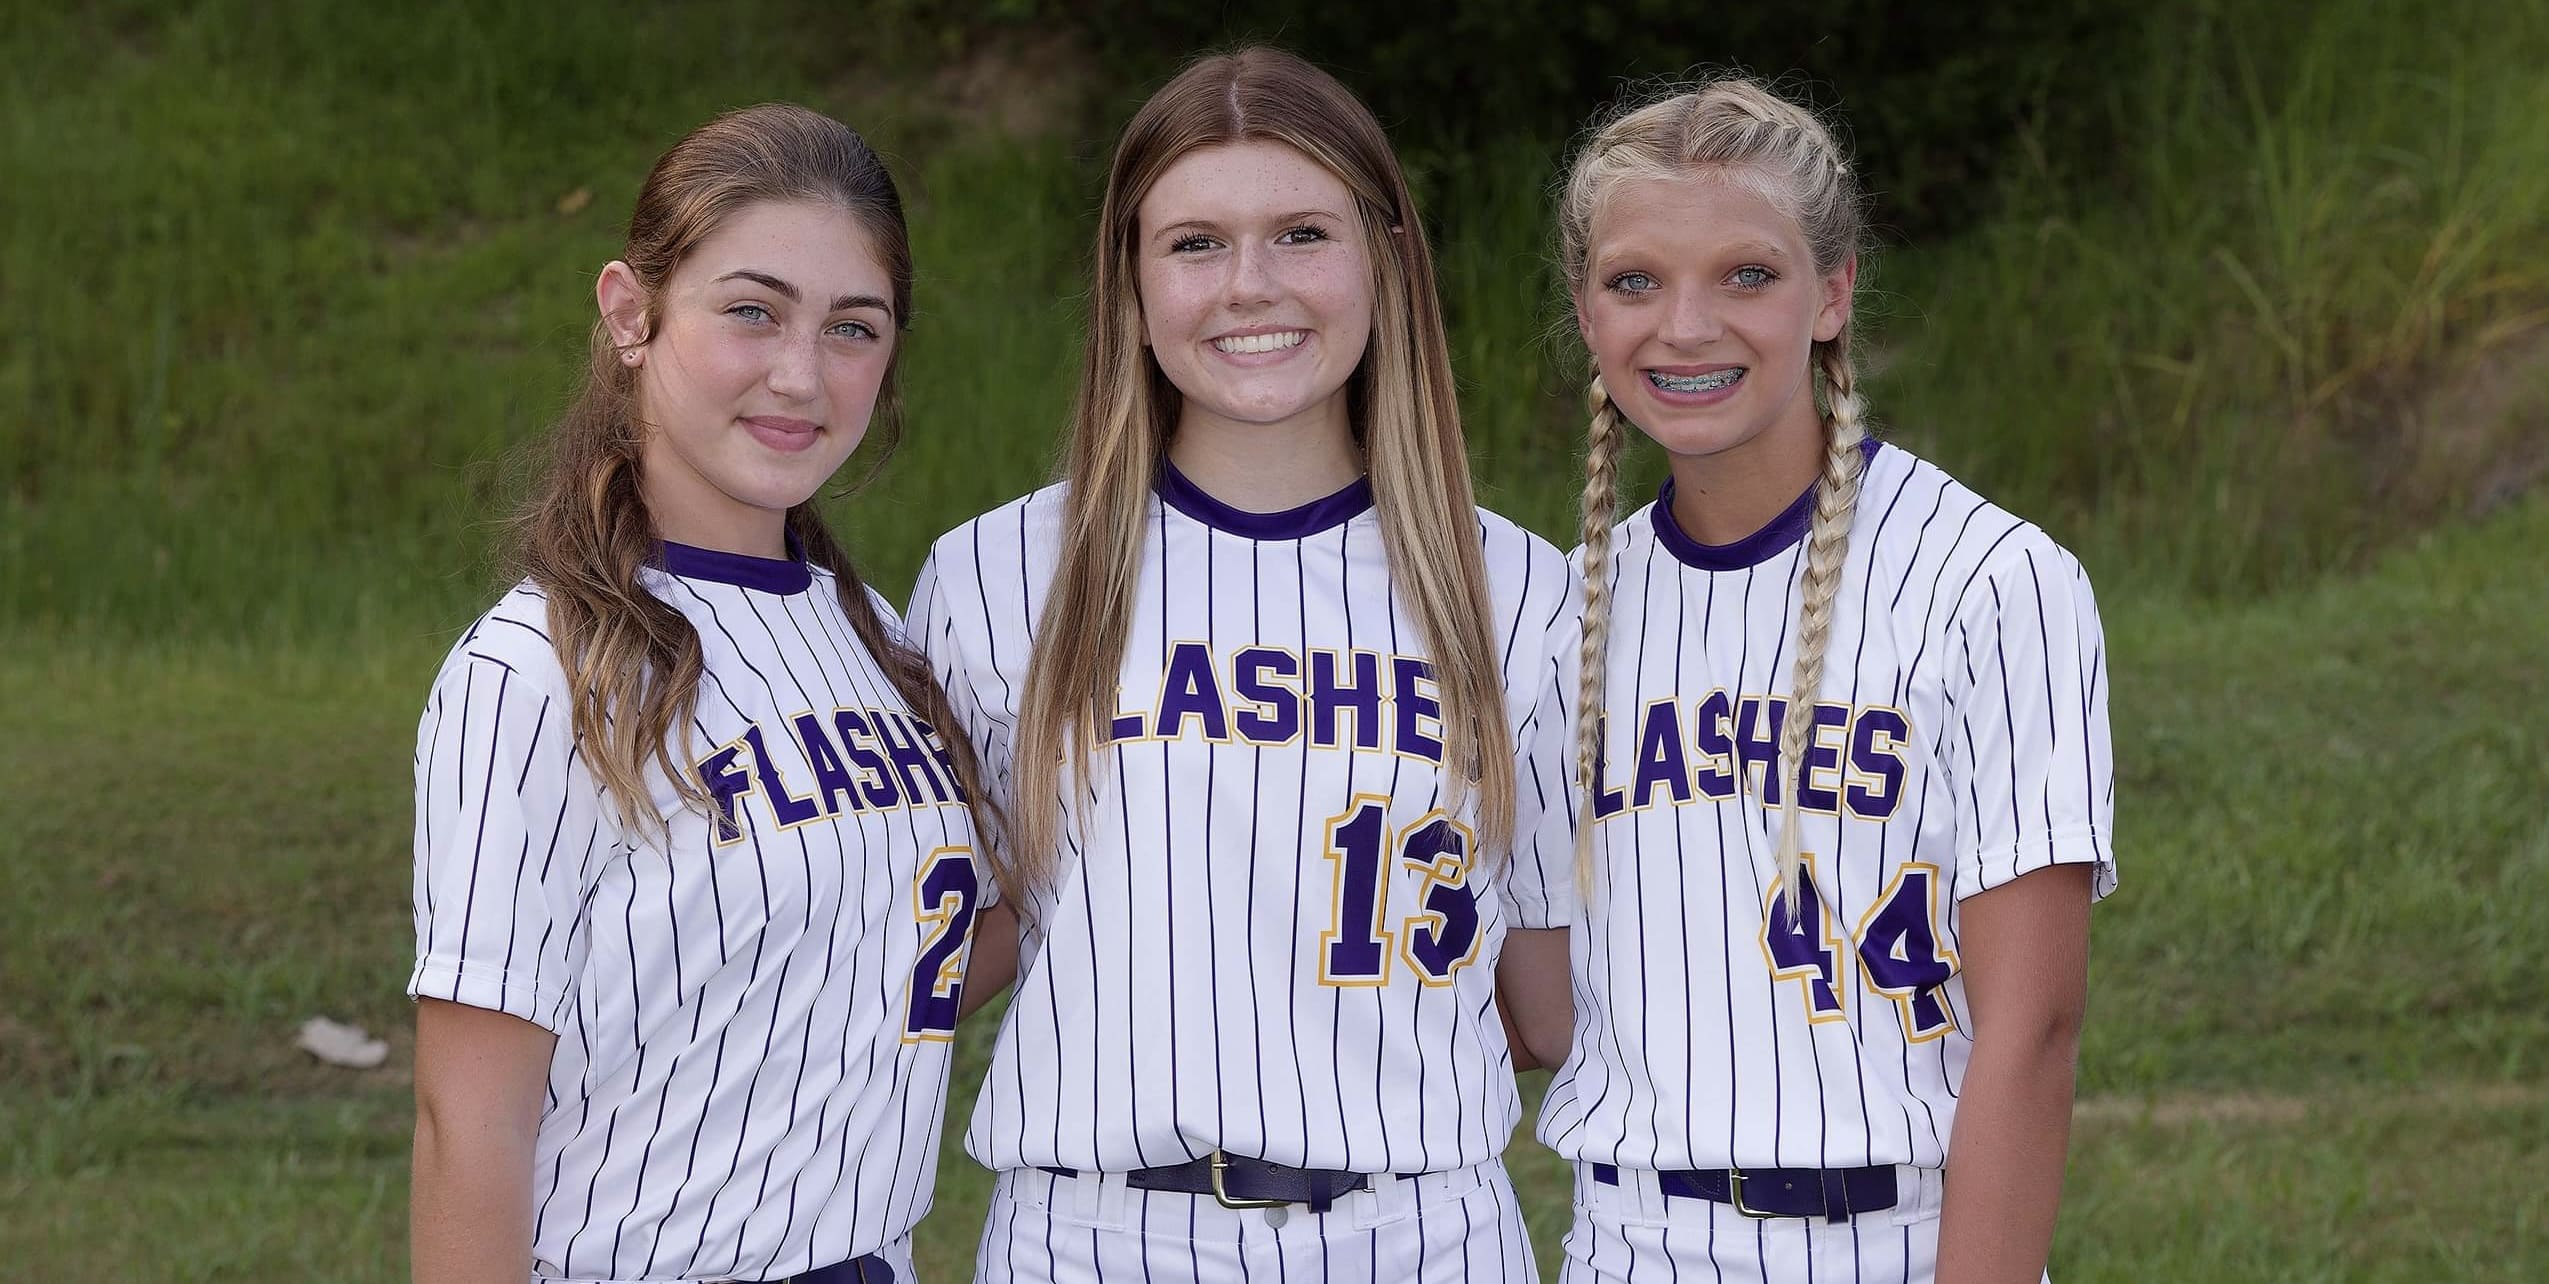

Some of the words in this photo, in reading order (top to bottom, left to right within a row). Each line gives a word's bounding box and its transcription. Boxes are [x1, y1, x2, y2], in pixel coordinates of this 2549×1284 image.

[686, 705, 968, 848] FLASHE
[1057, 639, 1482, 786] LASHE
[1575, 686, 1912, 824] LASHES
[900, 845, 978, 1045] 2
[1318, 792, 1485, 988] 13
[1758, 852, 1961, 1044] 44
